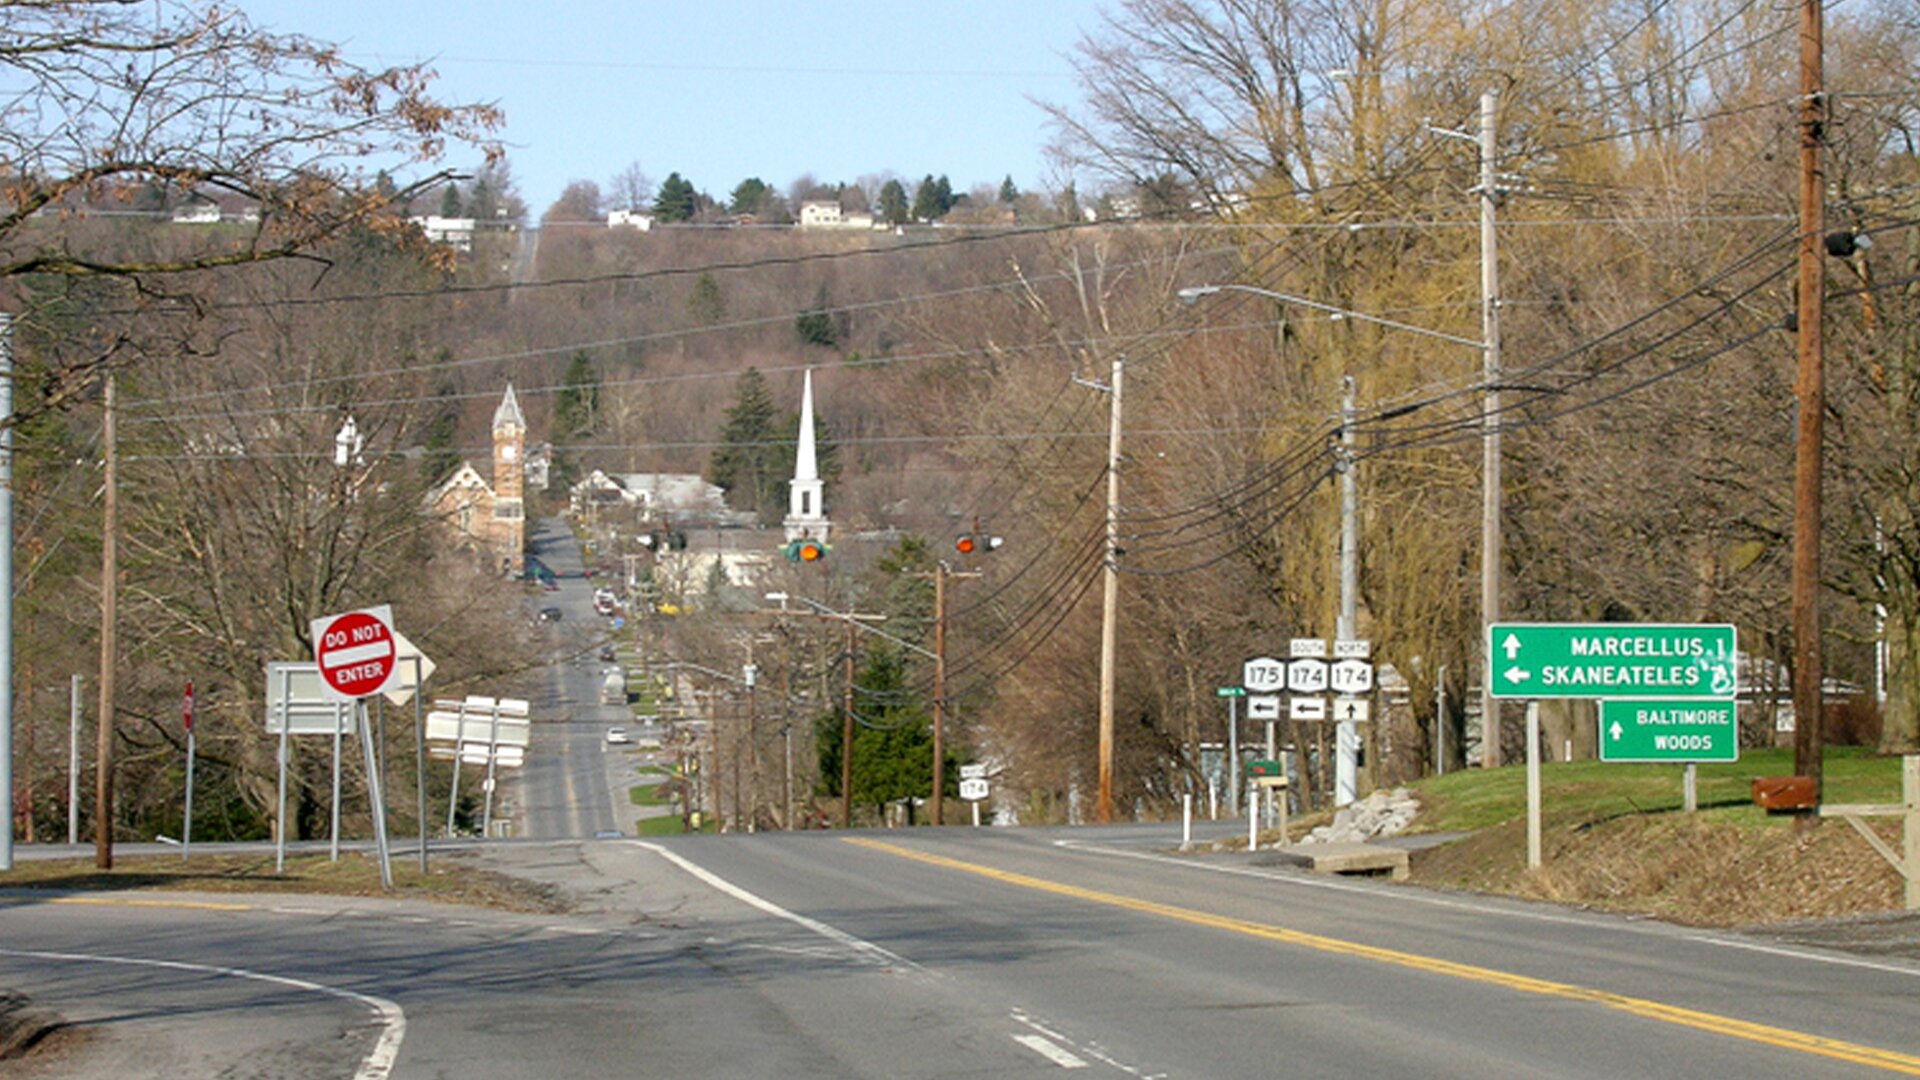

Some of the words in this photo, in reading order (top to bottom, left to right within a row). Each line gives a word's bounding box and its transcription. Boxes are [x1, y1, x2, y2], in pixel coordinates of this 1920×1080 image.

[326, 631, 347, 648] DO
[352, 623, 382, 642] NOT
[1571, 637, 1704, 656] MARCELLUS
[336, 661, 384, 685] ENTER
[1249, 666, 1279, 684] 175
[1293, 668, 1323, 684] 174
[1336, 668, 1368, 684] 174
[1541, 665, 1700, 686] SKANEATELES
[1636, 709, 1730, 725] BALTIMORE
[1654, 735, 1713, 750] WOODS
[963, 782, 985, 795] 174
